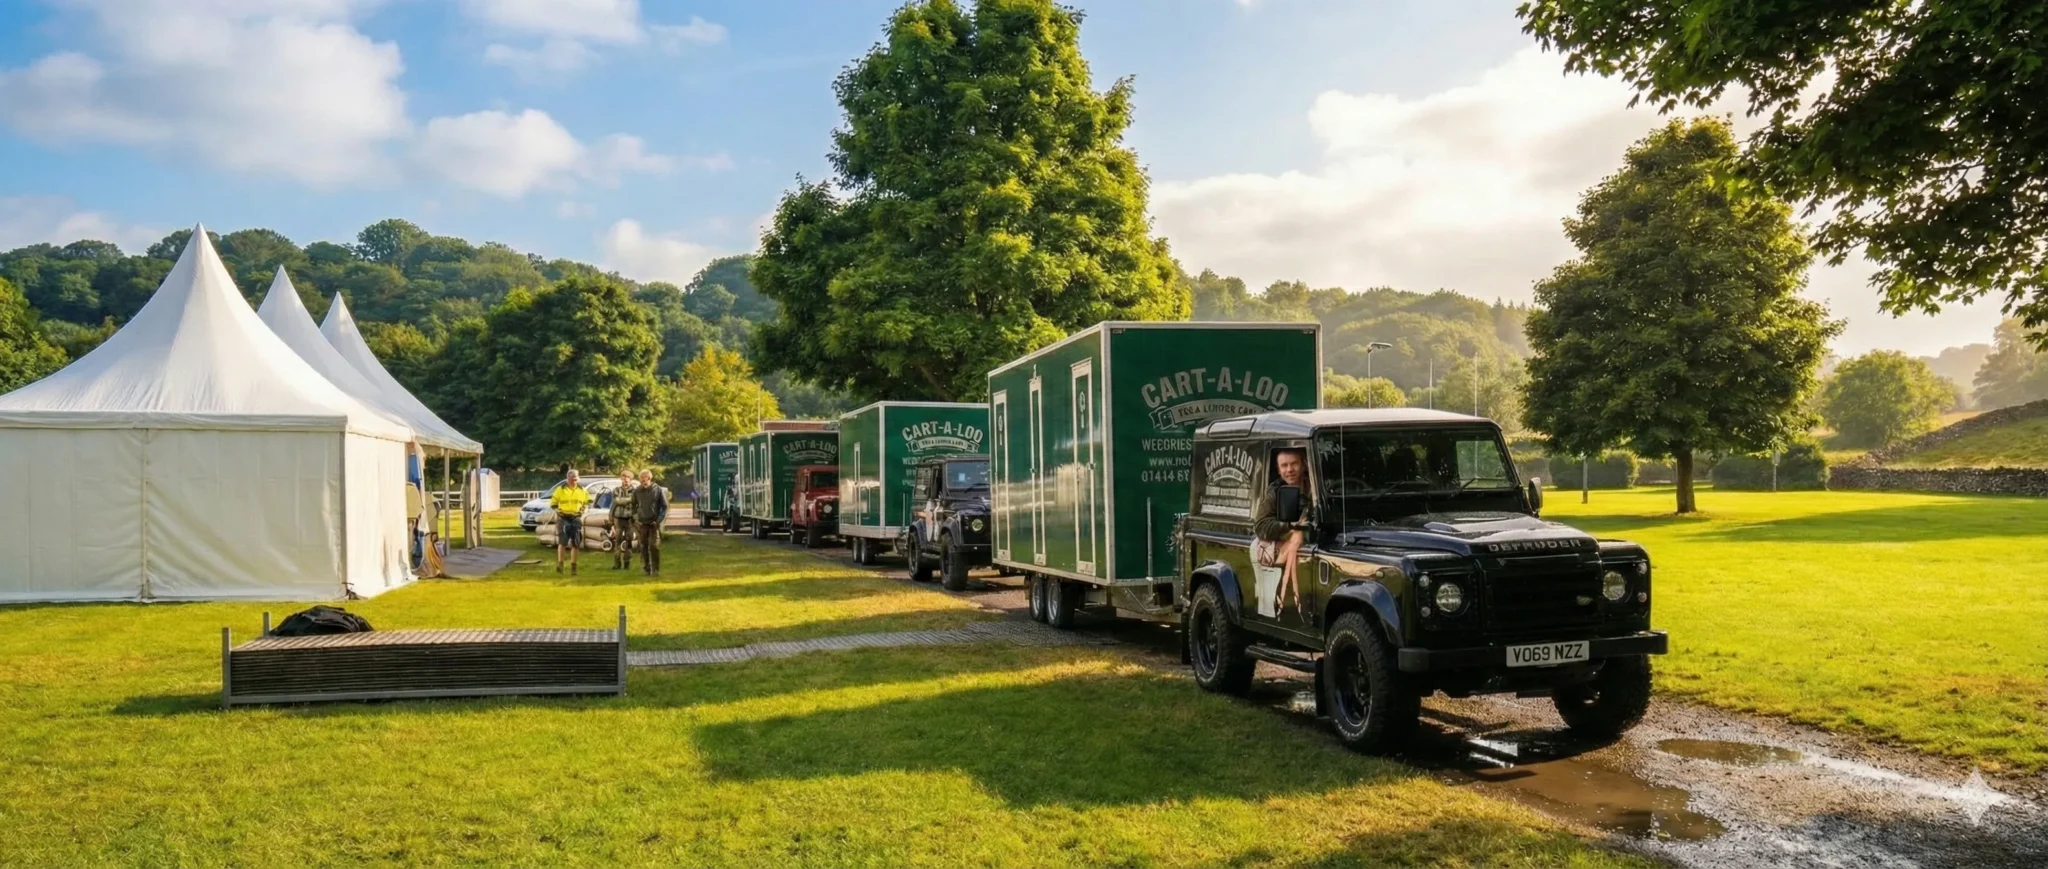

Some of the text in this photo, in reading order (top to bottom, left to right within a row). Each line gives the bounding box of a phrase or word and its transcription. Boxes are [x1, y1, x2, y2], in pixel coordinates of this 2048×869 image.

[1141, 366, 1289, 408] CART-A-LOO
[902, 421, 984, 443] CART-A-LOO
[1554, 643, 1583, 660] NZZ
